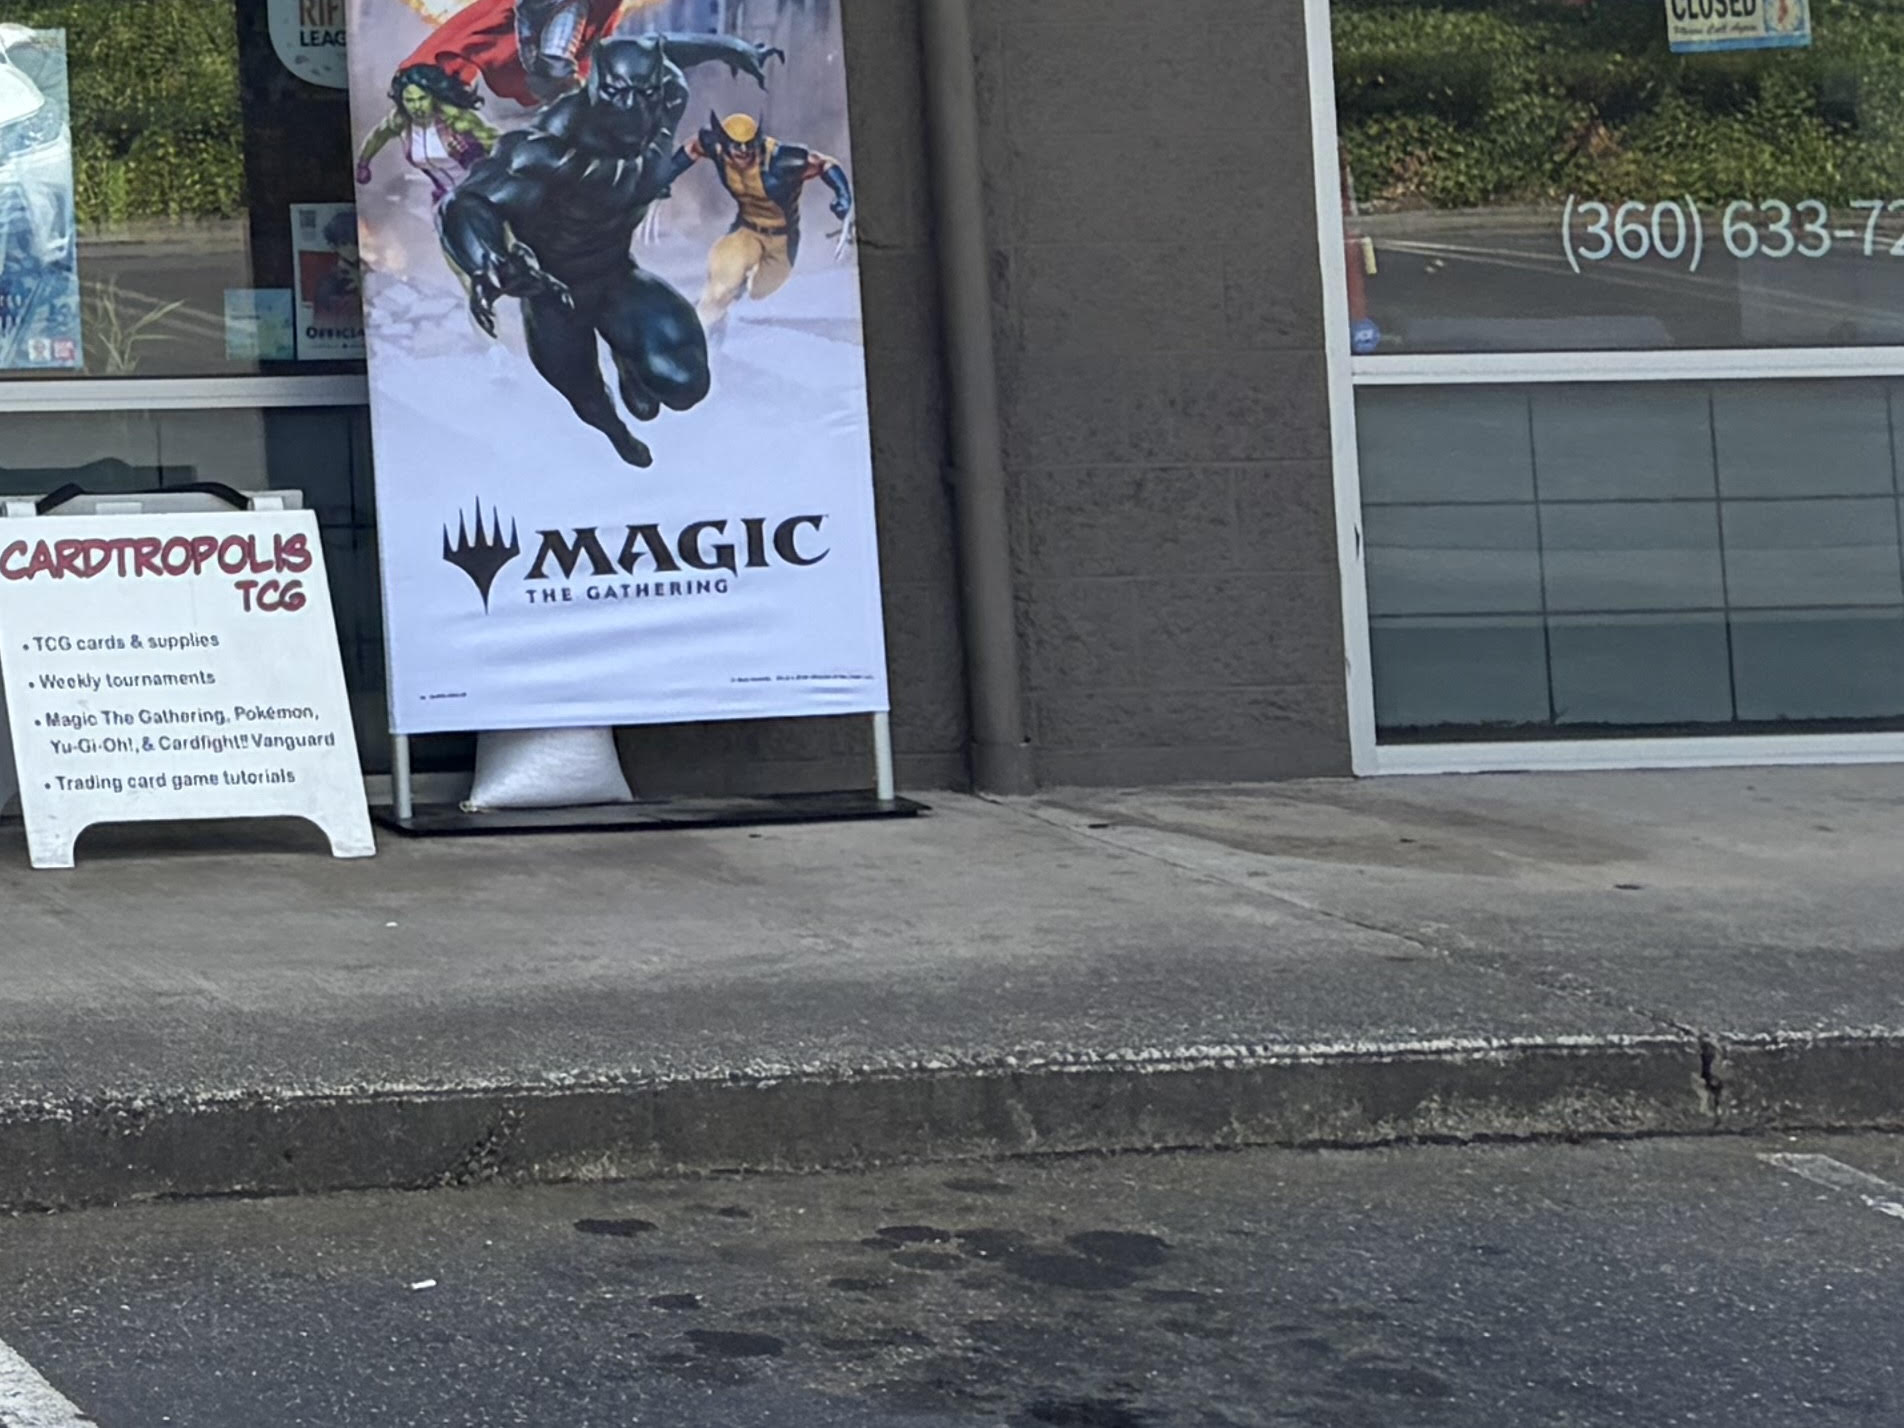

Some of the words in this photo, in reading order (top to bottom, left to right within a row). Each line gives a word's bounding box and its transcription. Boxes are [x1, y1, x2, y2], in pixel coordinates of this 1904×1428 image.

[300, 31, 346, 46] LEAG
[1562, 194, 1703, 274] (360)
[0, 533, 313, 580] CARDTROPOLIS
[523, 514, 831, 581] MAGIC
[234, 579, 307, 613] TCG
[525, 588, 573, 603] THE
[586, 578, 728, 601] GATHERING
[32, 636, 72, 652] TCG
[76, 634, 125, 651] cards
[130, 634, 144, 649] &
[147, 631, 220, 655] supplies
[39, 672, 101, 693] Weekly
[105, 669, 216, 688] tournaments
[45, 711, 98, 730] Magic
[101, 709, 134, 726] The
[138, 707, 232, 728] Gathering,
[234, 704, 320, 723] Pokémon,
[51, 736, 140, 756] Yu-Gi-Oh!,
[142, 736, 156, 752] &
[159, 734, 248, 756] Cardfight!!
[250, 731, 335, 751] Vanguard
[55, 774, 123, 794] Trading
[127, 771, 167, 790] card
[172, 773, 219, 791] game
[223, 768, 296, 786] tutorials
